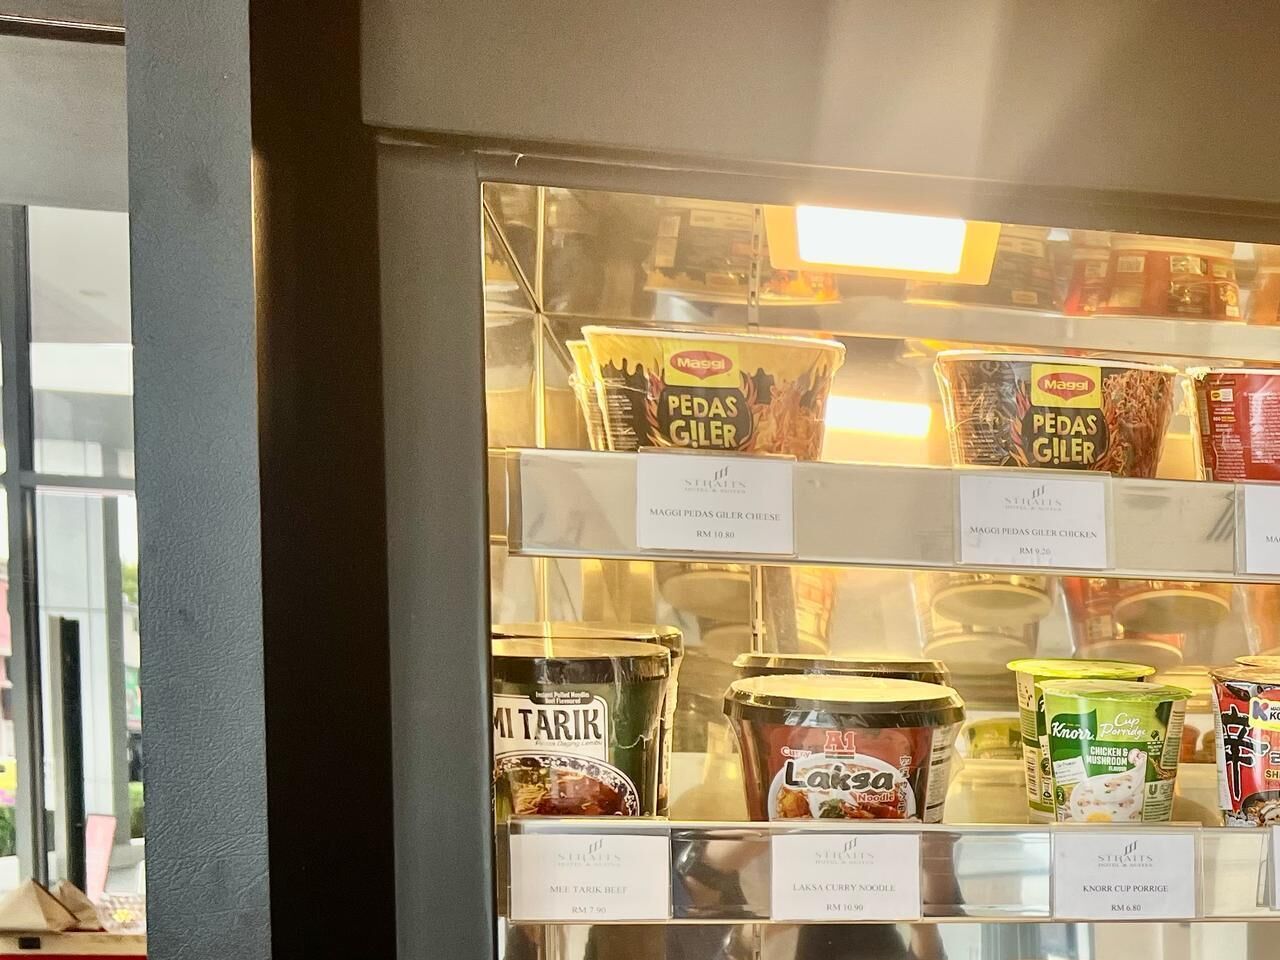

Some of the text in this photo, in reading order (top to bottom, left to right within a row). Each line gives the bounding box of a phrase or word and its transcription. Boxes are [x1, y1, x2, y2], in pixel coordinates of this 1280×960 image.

[677, 357, 725, 371] Maggi
[1044, 379, 1088, 391] Maggi
[668, 395, 738, 418] PEDAS
[1033, 412, 1097, 436] PEDAS
[650, 508, 781, 521] MAGGI PEDAS GILER CHEESE
[696, 530, 711, 538] RM
[970, 526, 1097, 538] MAGGI PEDAS GILER CHICKEN
[1019, 547, 1033, 555] RM
[518, 709, 602, 741] TARIK
[1114, 712, 1140, 727] Cup
[1052, 721, 1094, 740] Knorr
[1100, 723, 1147, 740] Porridge
[781, 747, 812, 759] Curry
[1090, 746, 1129, 756] CHICKEN &
[1086, 755, 1128, 765] MUSHROOM
[785, 762, 895, 791] Laksa
[857, 792, 896, 802] Noodle
[573, 886, 602, 894] TARIK
[793, 884, 896, 892] LAKSA CURRY NOODLE
[1083, 885, 1112, 893] KNORR
[1114, 885, 1131, 893] CUP
[826, 904, 864, 912] RM 10.90
